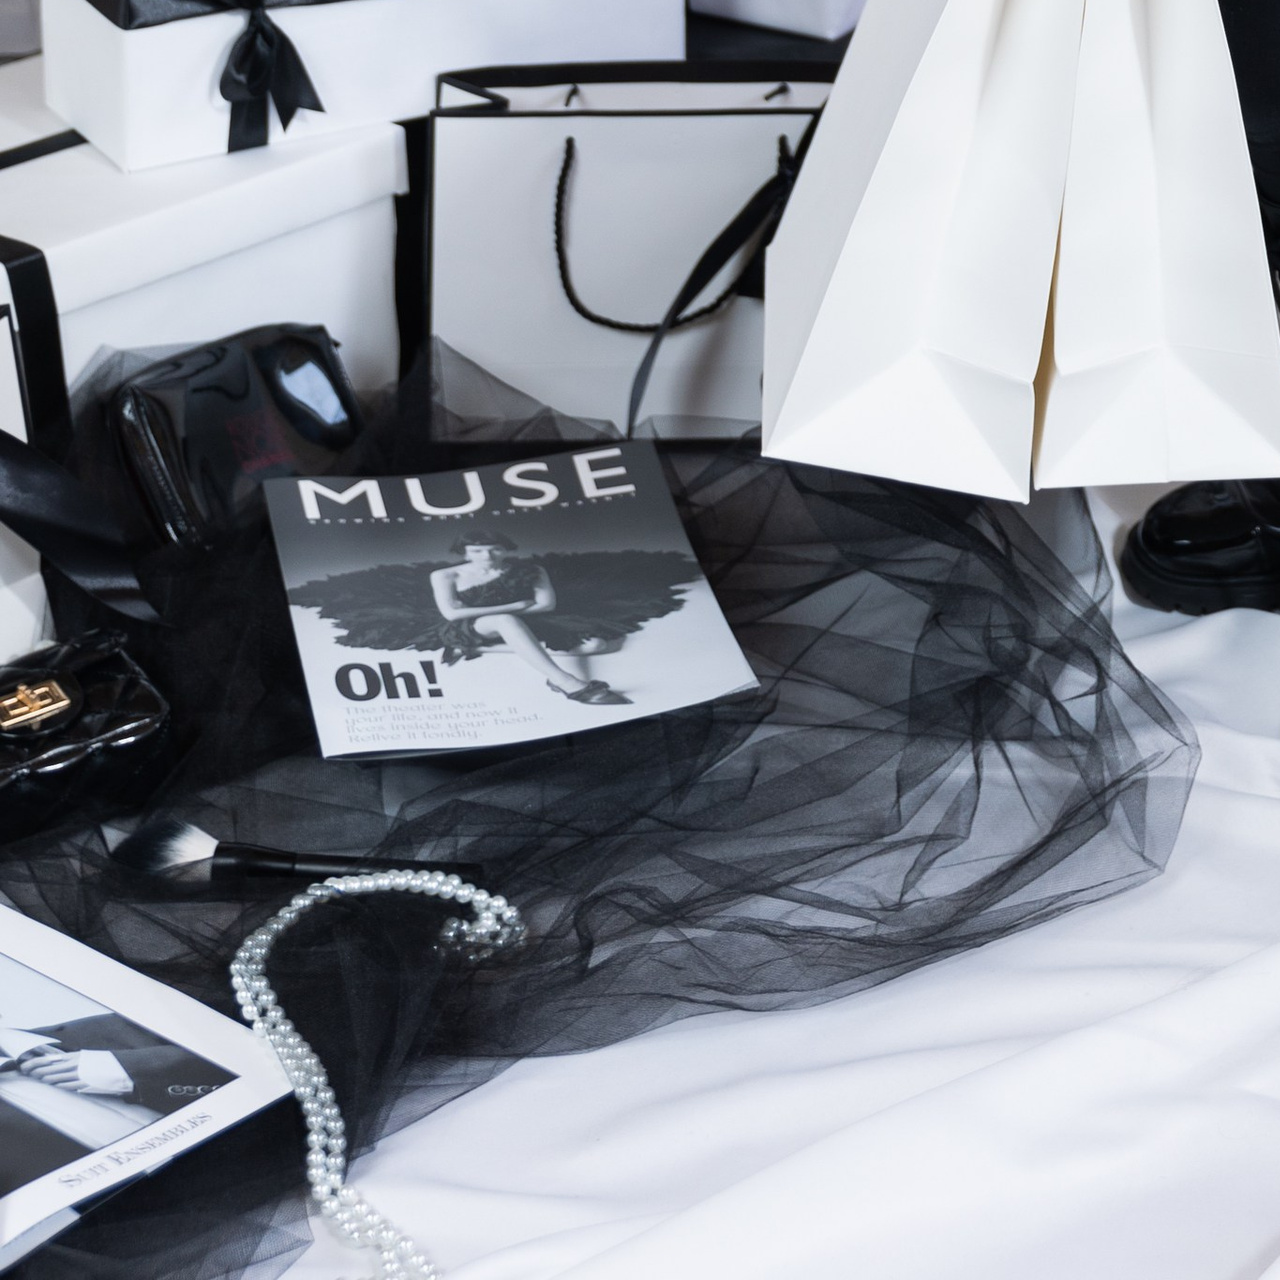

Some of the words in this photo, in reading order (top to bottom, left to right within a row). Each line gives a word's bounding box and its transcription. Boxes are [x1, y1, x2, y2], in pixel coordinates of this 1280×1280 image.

[298, 447, 637, 521] MUSE
[335, 660, 443, 701] Oh!
[345, 716, 387, 727] your
[427, 711, 460, 721] and
[466, 709, 502, 719] now
[508, 706, 518, 715] it
[346, 706, 377, 715] The
[382, 704, 444, 714] theater
[451, 702, 486, 711] was
[346, 725, 386, 735] lives
[390, 722, 441, 732] inside
[448, 720, 489, 731] your
[494, 713, 545, 726] head.
[349, 733, 401, 744] Relive
[407, 731, 417, 740] it
[422, 729, 483, 741] fondly.
[59, 1160, 110, 1188] SUIT
[108, 1112, 212, 1166] ENSEMBLES
